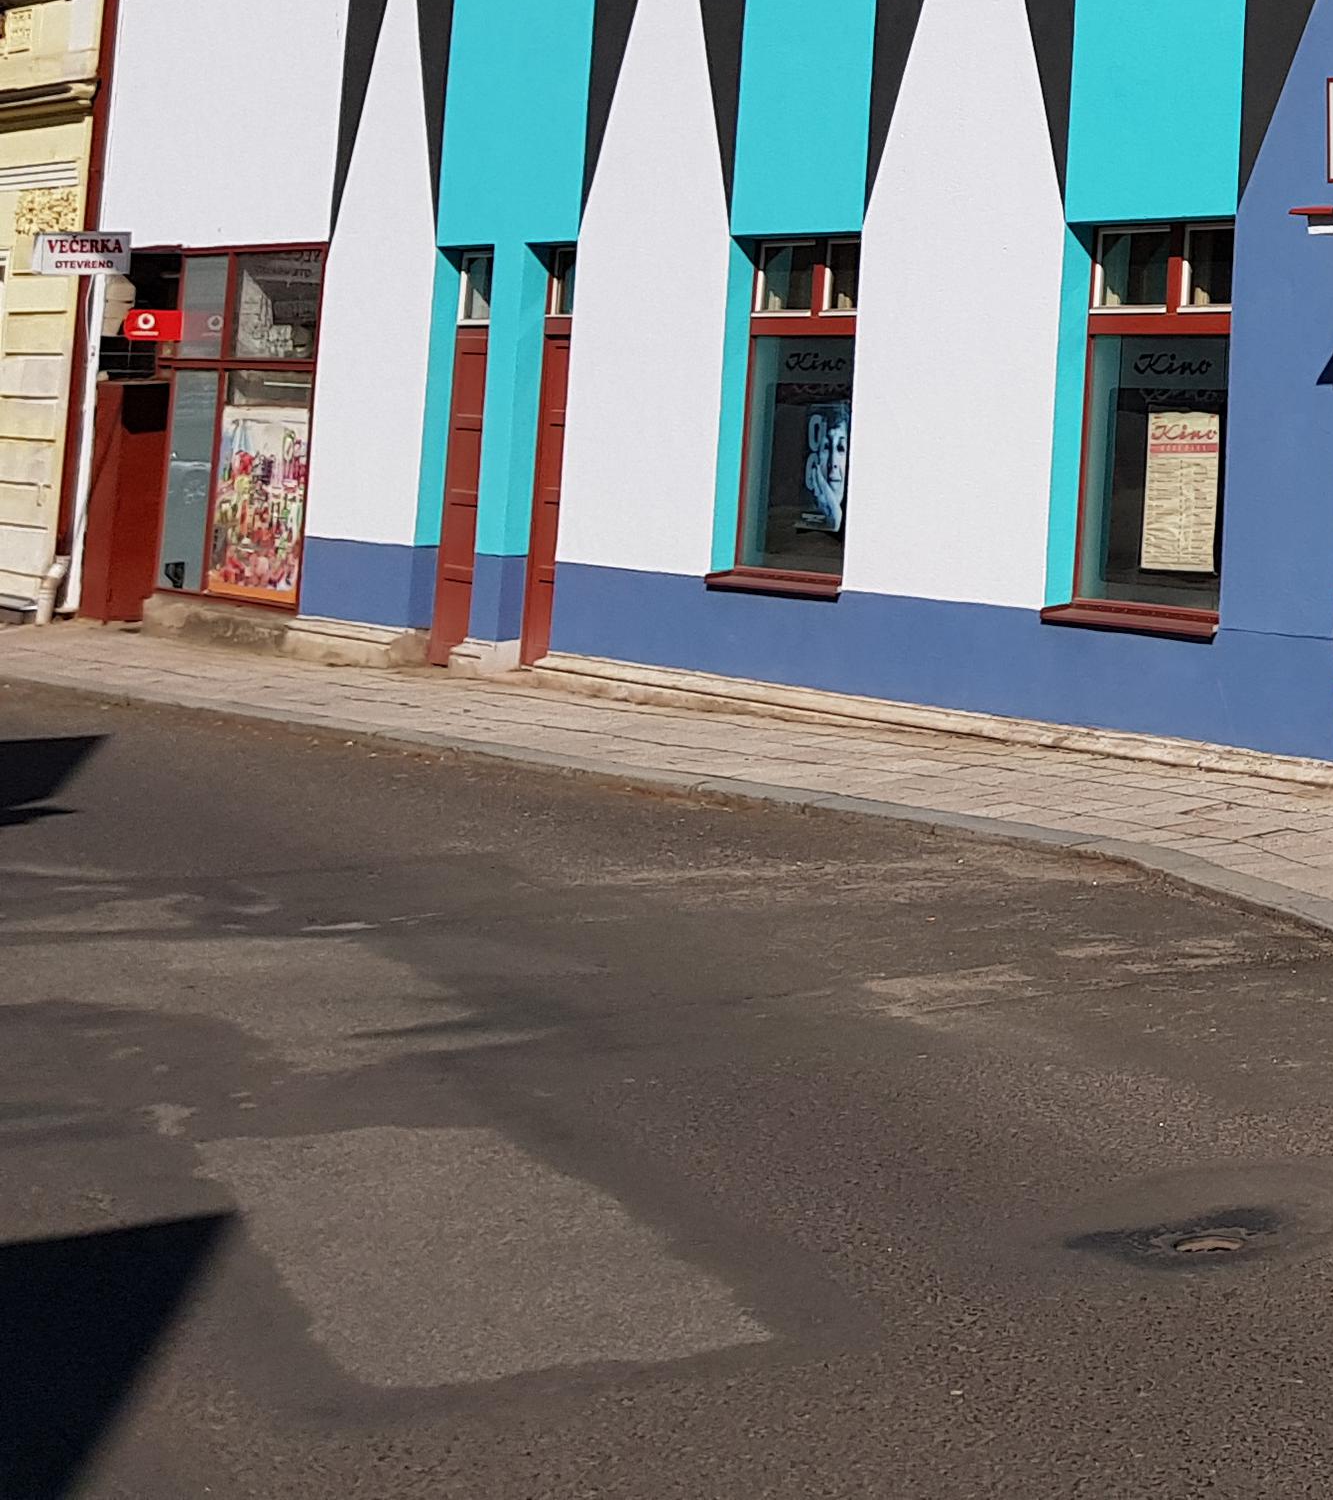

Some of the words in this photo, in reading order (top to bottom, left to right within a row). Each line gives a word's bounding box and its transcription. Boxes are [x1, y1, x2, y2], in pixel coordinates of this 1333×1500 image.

[47, 234, 123, 253] VEČERKA
[786, 353, 846, 371] Kino
[1134, 353, 1213, 375] Kino
[1151, 424, 1217, 440] Kino
